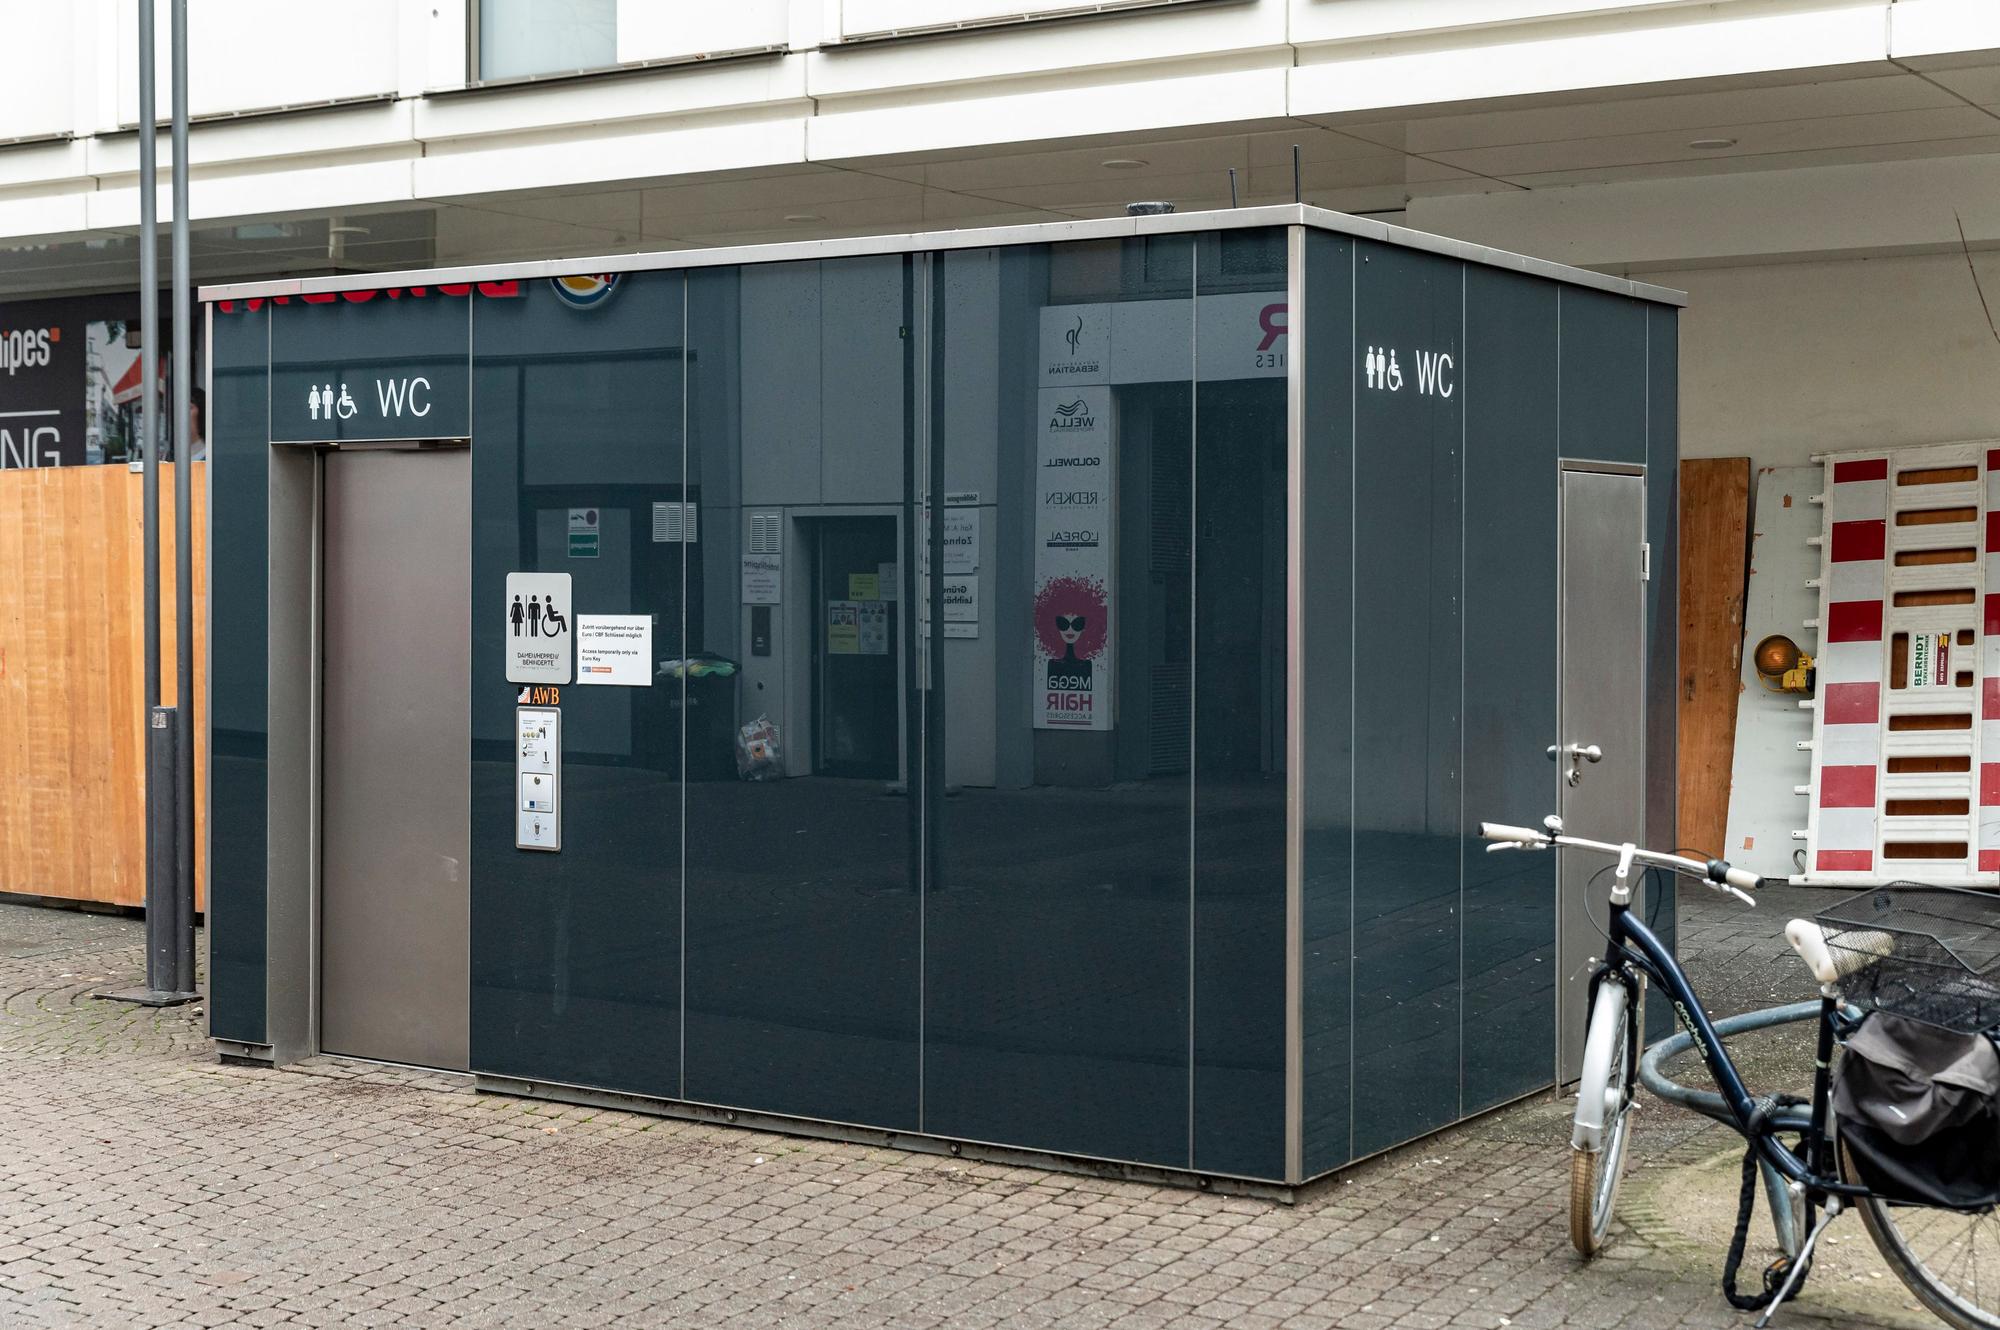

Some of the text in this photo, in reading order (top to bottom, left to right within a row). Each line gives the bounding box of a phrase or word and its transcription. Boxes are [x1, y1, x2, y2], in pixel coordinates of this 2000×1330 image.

[1415, 349, 1453, 398] WC
[376, 377, 431, 417] WC
[1914, 634, 1923, 686] BERNDT
[532, 687, 560, 704] AWB
